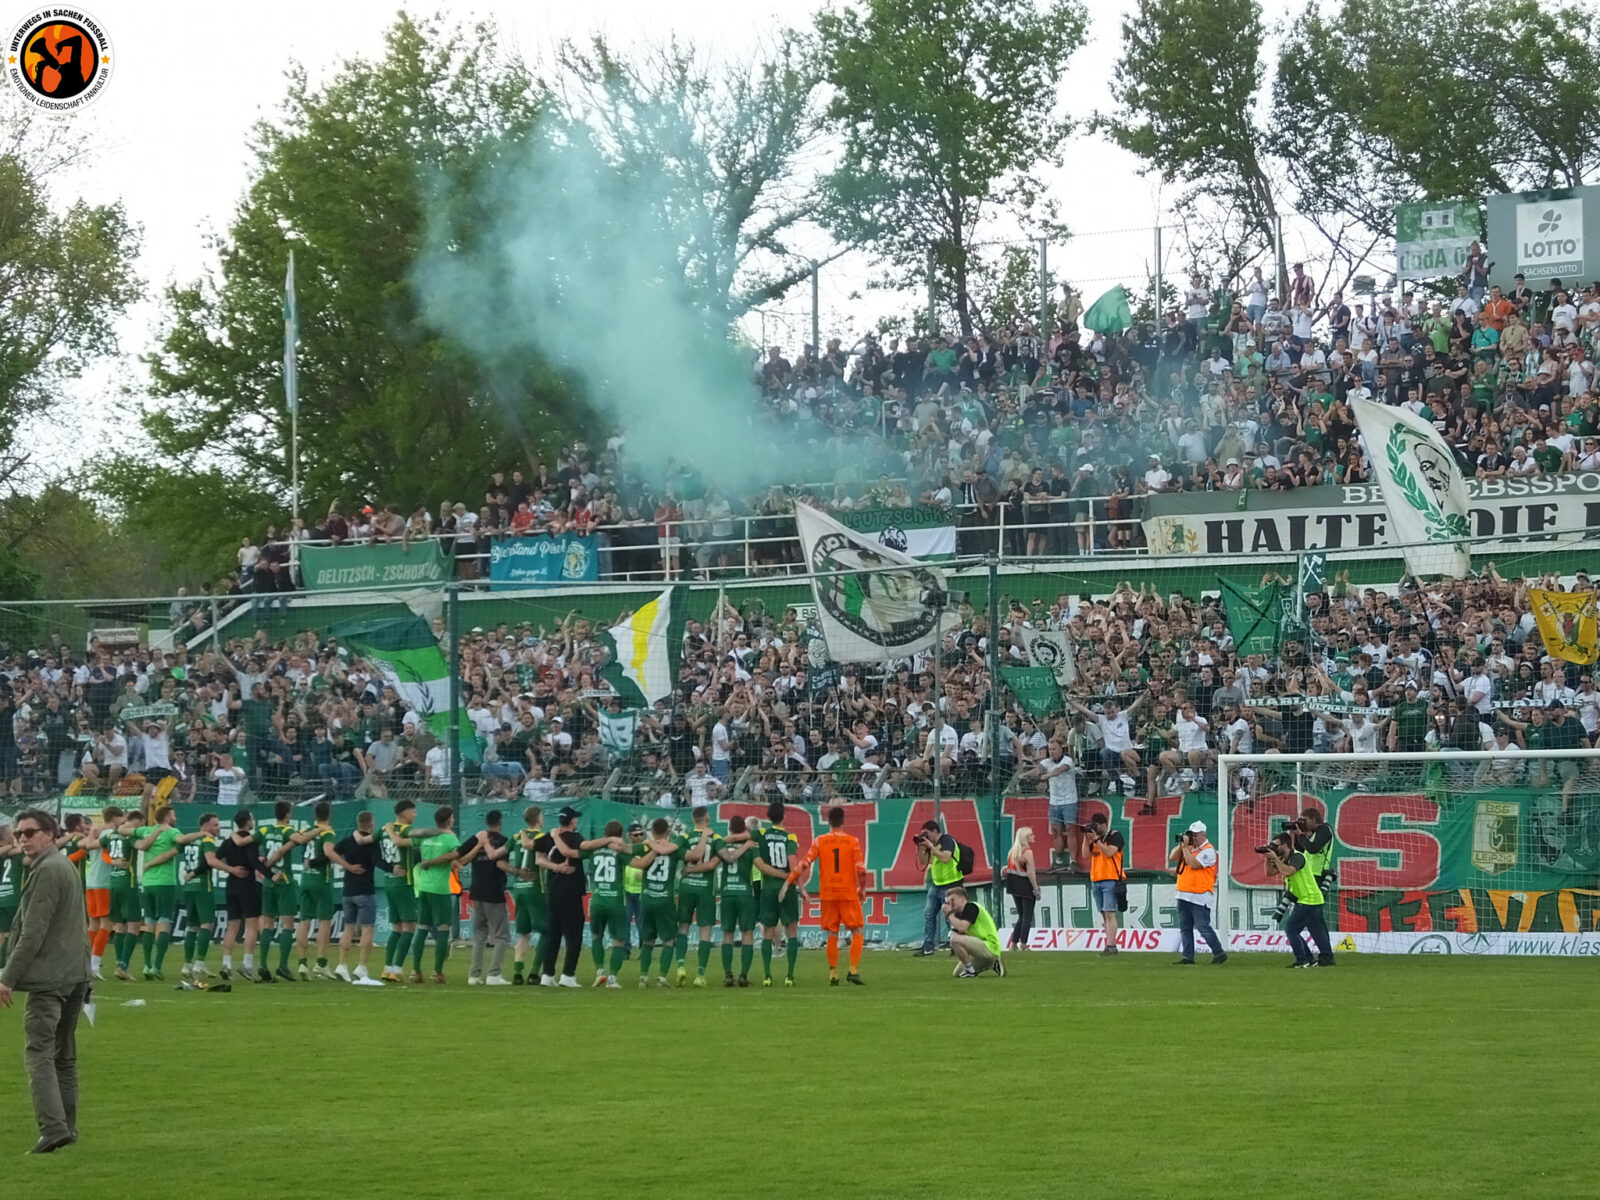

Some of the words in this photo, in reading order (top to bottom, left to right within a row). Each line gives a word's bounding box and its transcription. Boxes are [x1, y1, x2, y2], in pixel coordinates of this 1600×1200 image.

[1524, 238, 1577, 259] LOTTO
[1523, 263, 1578, 277] SACHSENLOTTO
[1205, 513, 1387, 553] HALTE
[1469, 502, 1559, 544] DIE
[317, 565, 376, 584] DELITZSCH
[767, 841, 788, 868] 10
[832, 848, 840, 874] 1
[2, 858, 12, 883] 2
[593, 855, 616, 883] 26
[646, 855, 670, 882] 23
